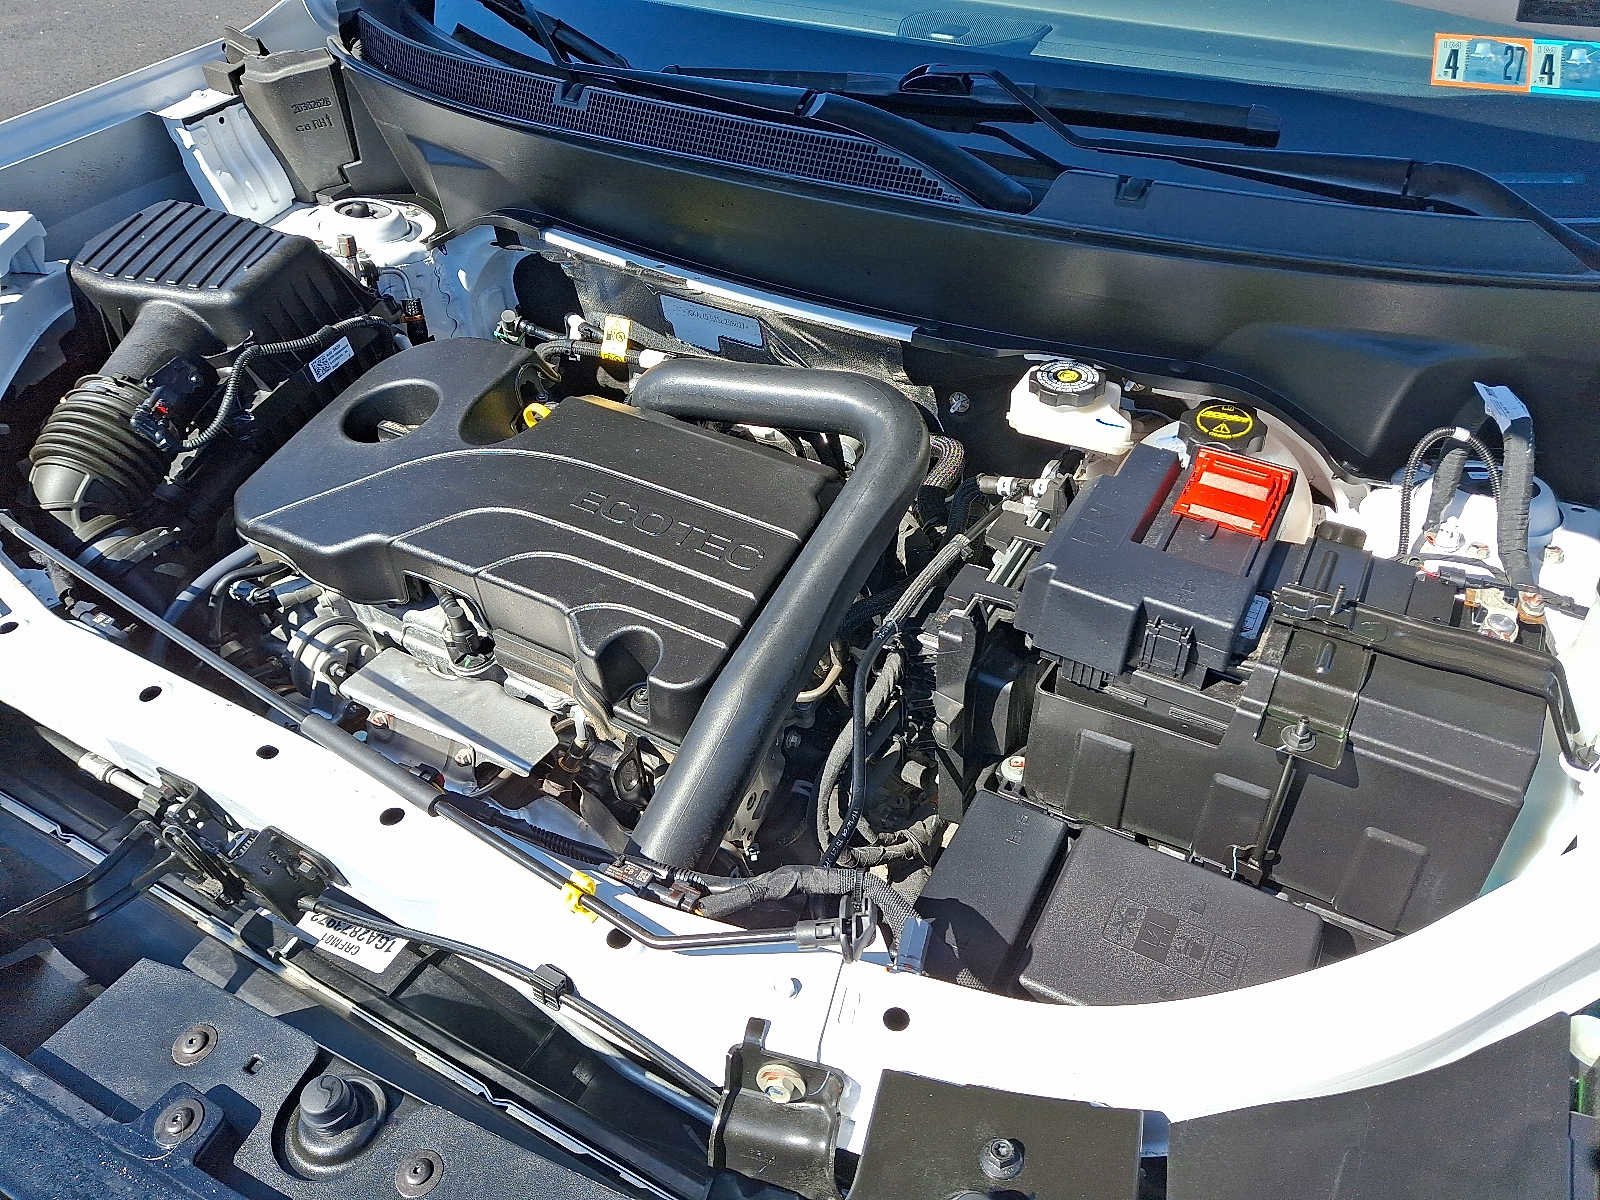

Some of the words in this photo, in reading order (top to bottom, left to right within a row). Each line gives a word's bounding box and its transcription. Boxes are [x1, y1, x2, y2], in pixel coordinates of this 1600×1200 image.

[1444, 48, 1460, 80] 4
[1504, 45, 1528, 84] 27
[1539, 53, 1555, 86] 4
[569, 490, 766, 571] ECOTEC
